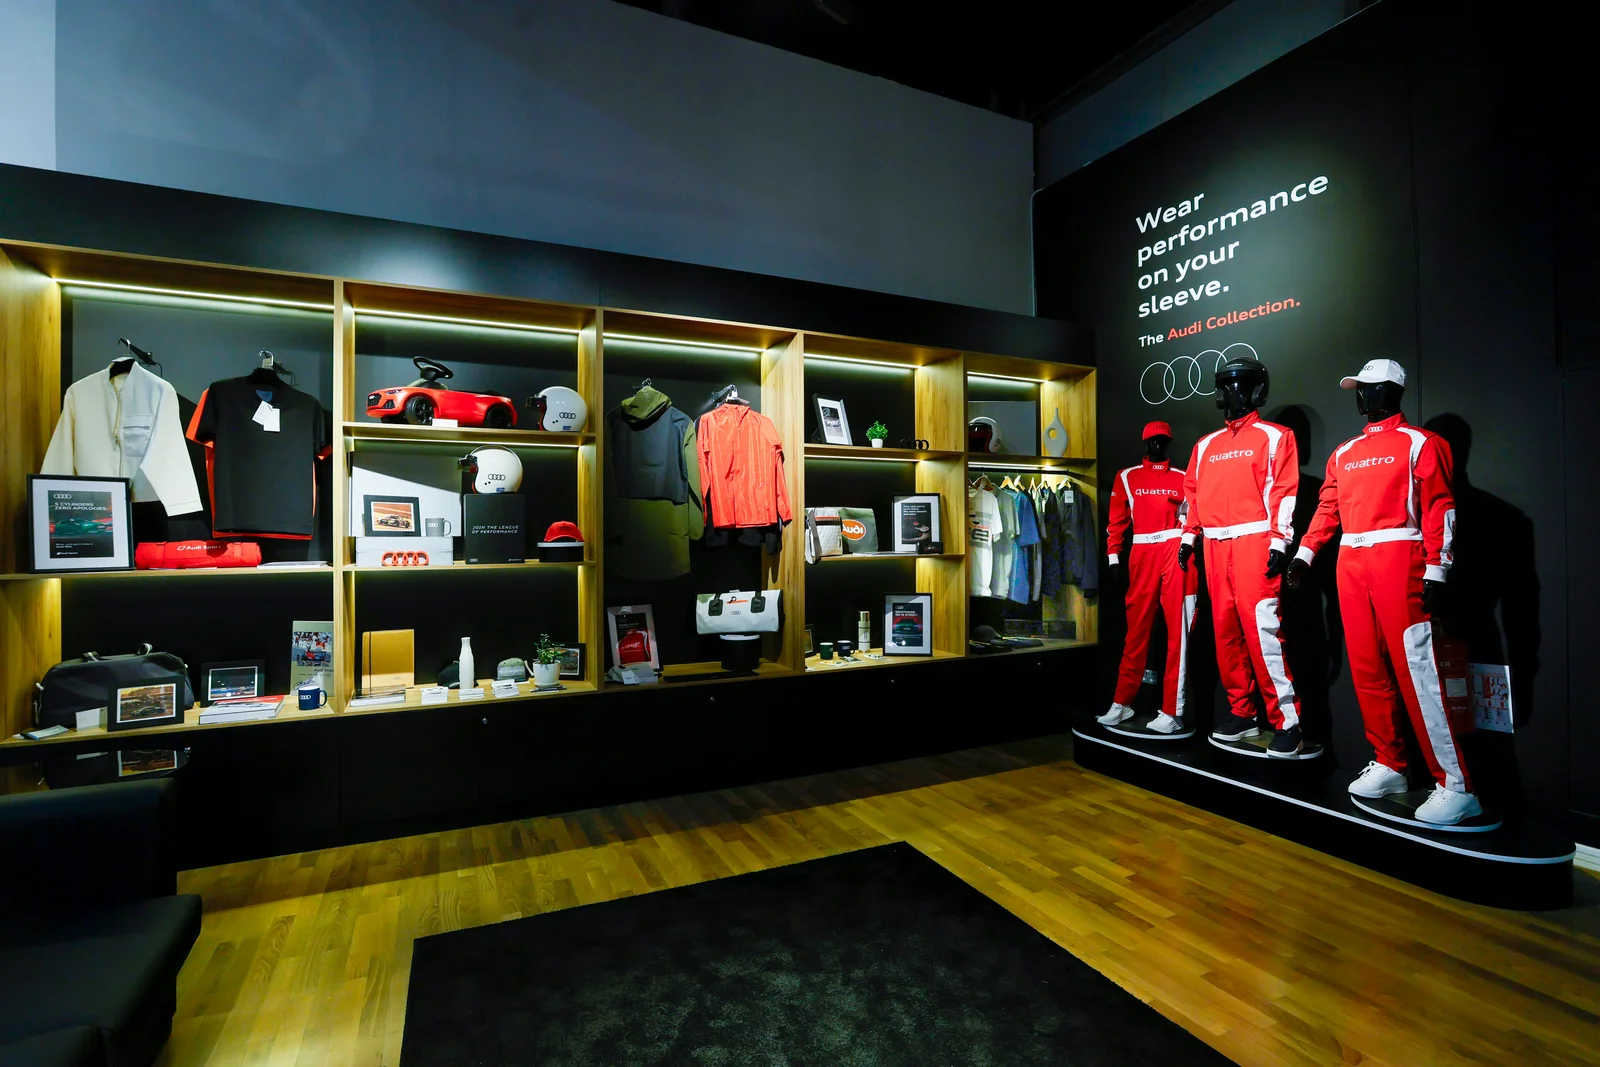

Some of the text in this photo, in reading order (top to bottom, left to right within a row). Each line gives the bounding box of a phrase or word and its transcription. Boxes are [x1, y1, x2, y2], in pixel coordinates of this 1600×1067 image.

[1135, 192, 1204, 234] Wear
[1138, 175, 1329, 268] performance
[1138, 241, 1240, 290] on your
[1138, 280, 1230, 318] sleeve.
[1138, 297, 1301, 348] The Audi Collection.
[1209, 448, 1254, 463] quattro
[1344, 455, 1395, 471] quattro
[1135, 488, 1178, 496] quattro
